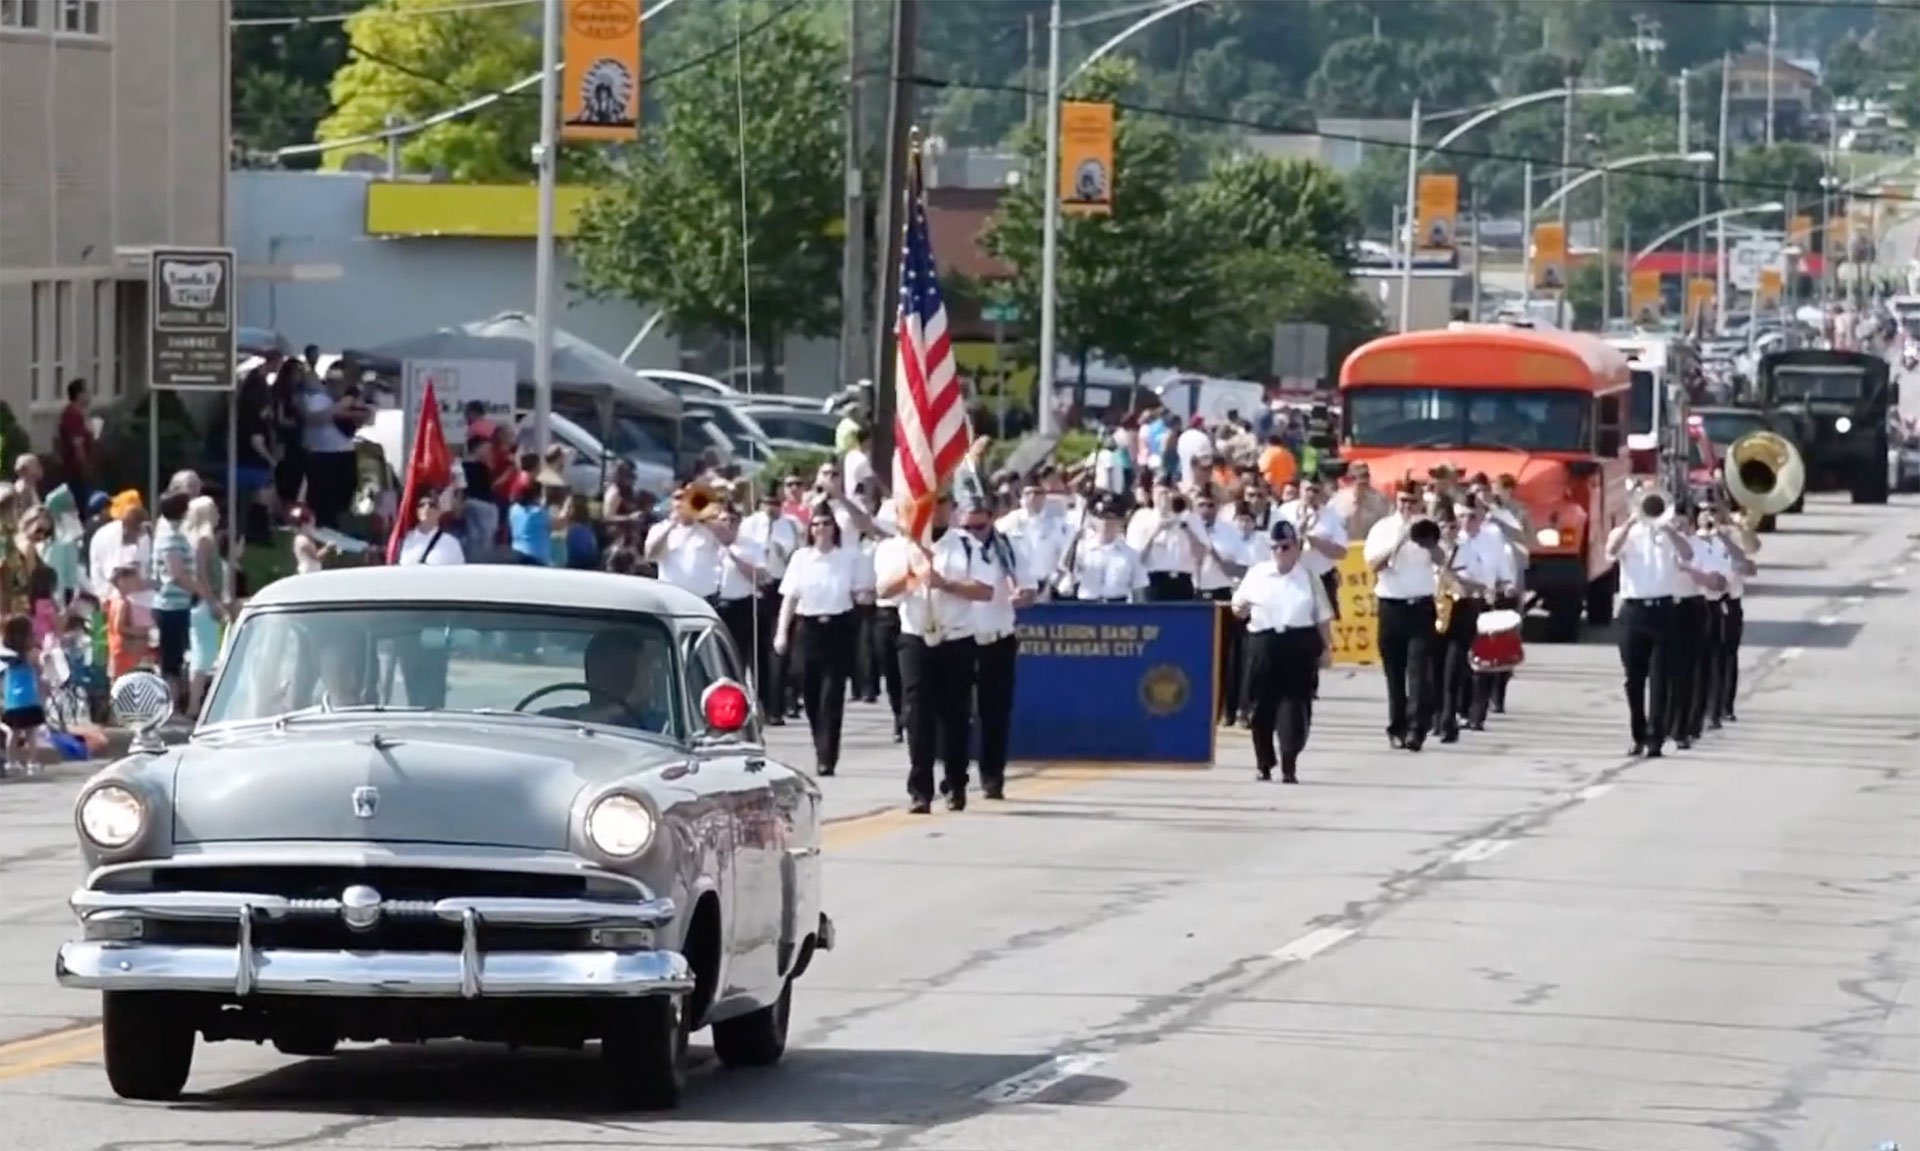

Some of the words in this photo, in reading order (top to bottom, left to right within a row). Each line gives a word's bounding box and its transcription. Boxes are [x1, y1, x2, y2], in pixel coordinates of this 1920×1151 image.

[176, 287, 213, 304] Trail
[1050, 624, 1096, 640] LEGION
[1100, 624, 1138, 640] BAND
[1142, 625, 1161, 640] OF
[1055, 641, 1110, 657] KANSAS
[1113, 641, 1145, 657] CITY
